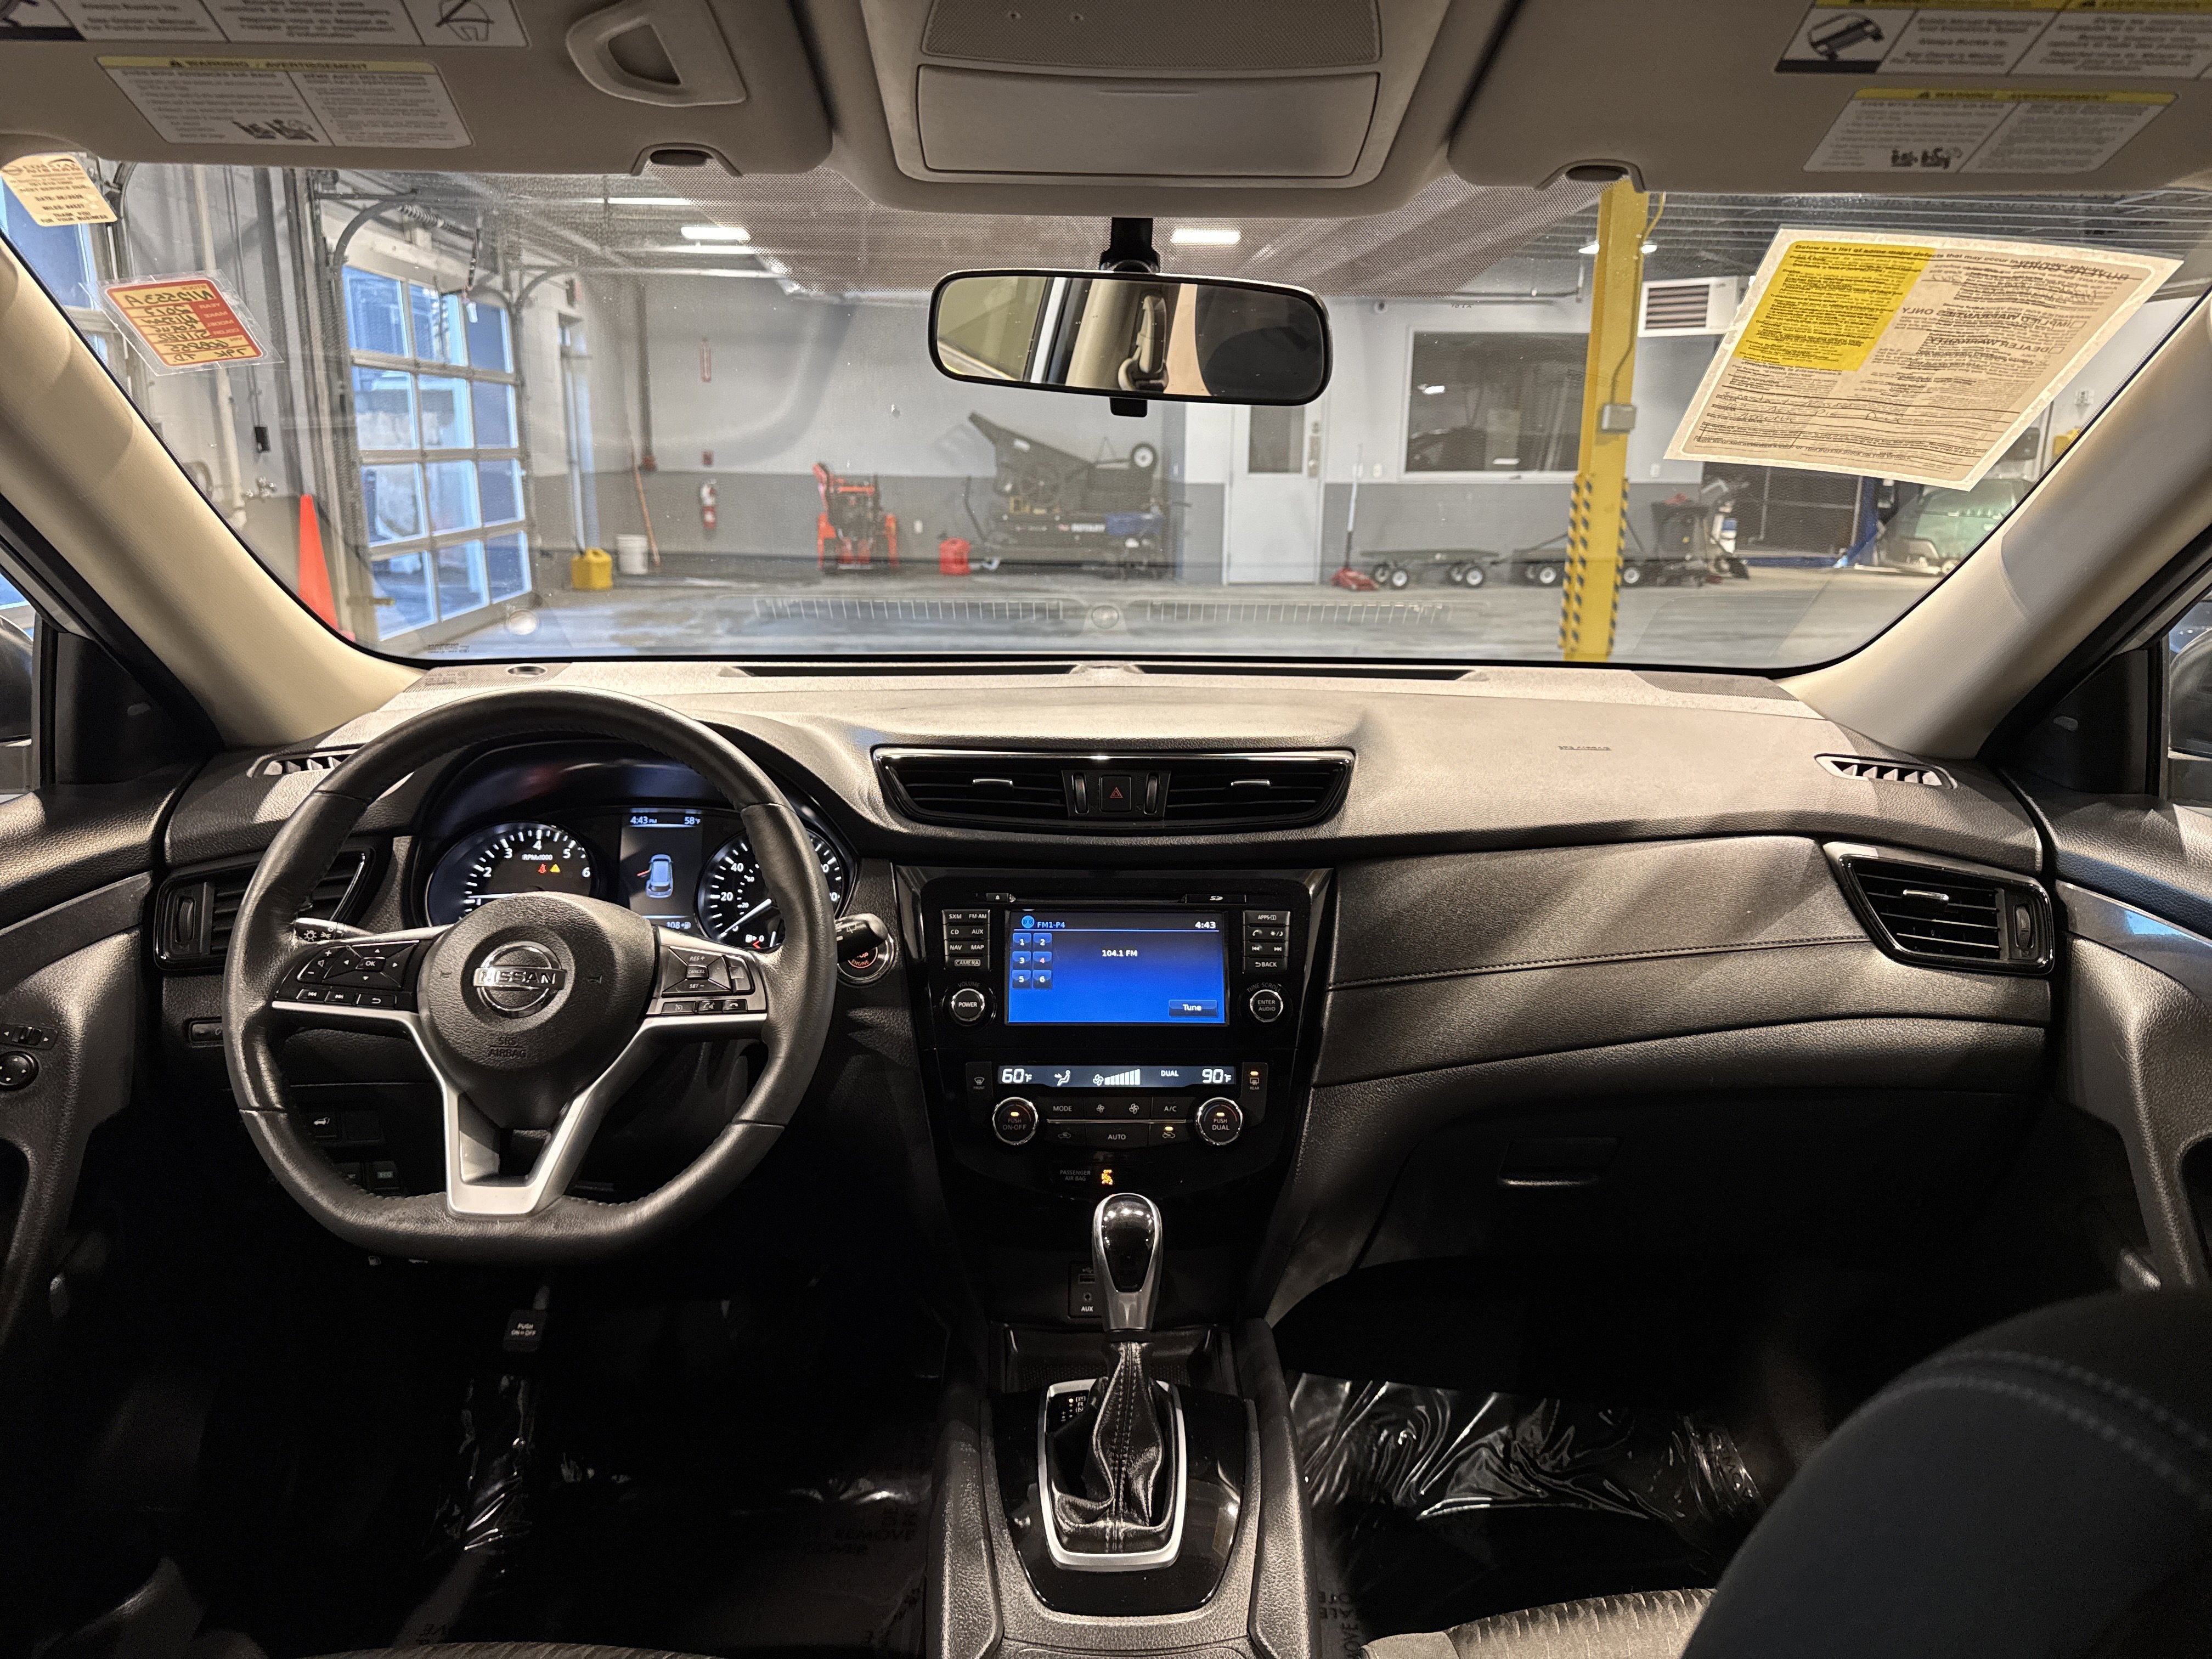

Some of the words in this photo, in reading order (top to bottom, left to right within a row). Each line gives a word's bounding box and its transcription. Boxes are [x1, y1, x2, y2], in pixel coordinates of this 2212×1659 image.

[630, 816, 648, 824] 4:43
[532, 840, 542, 850] 4
[504, 848, 512, 859] 3
[562, 848, 571, 859] 5
[483, 867, 492, 877] 2
[582, 867, 591, 878] 6
[730, 863, 744, 872] 40
[720, 891, 733, 901] 20
[478, 970, 556, 985] NISSAN
[488, 1048, 527, 1058] AIRBAG
